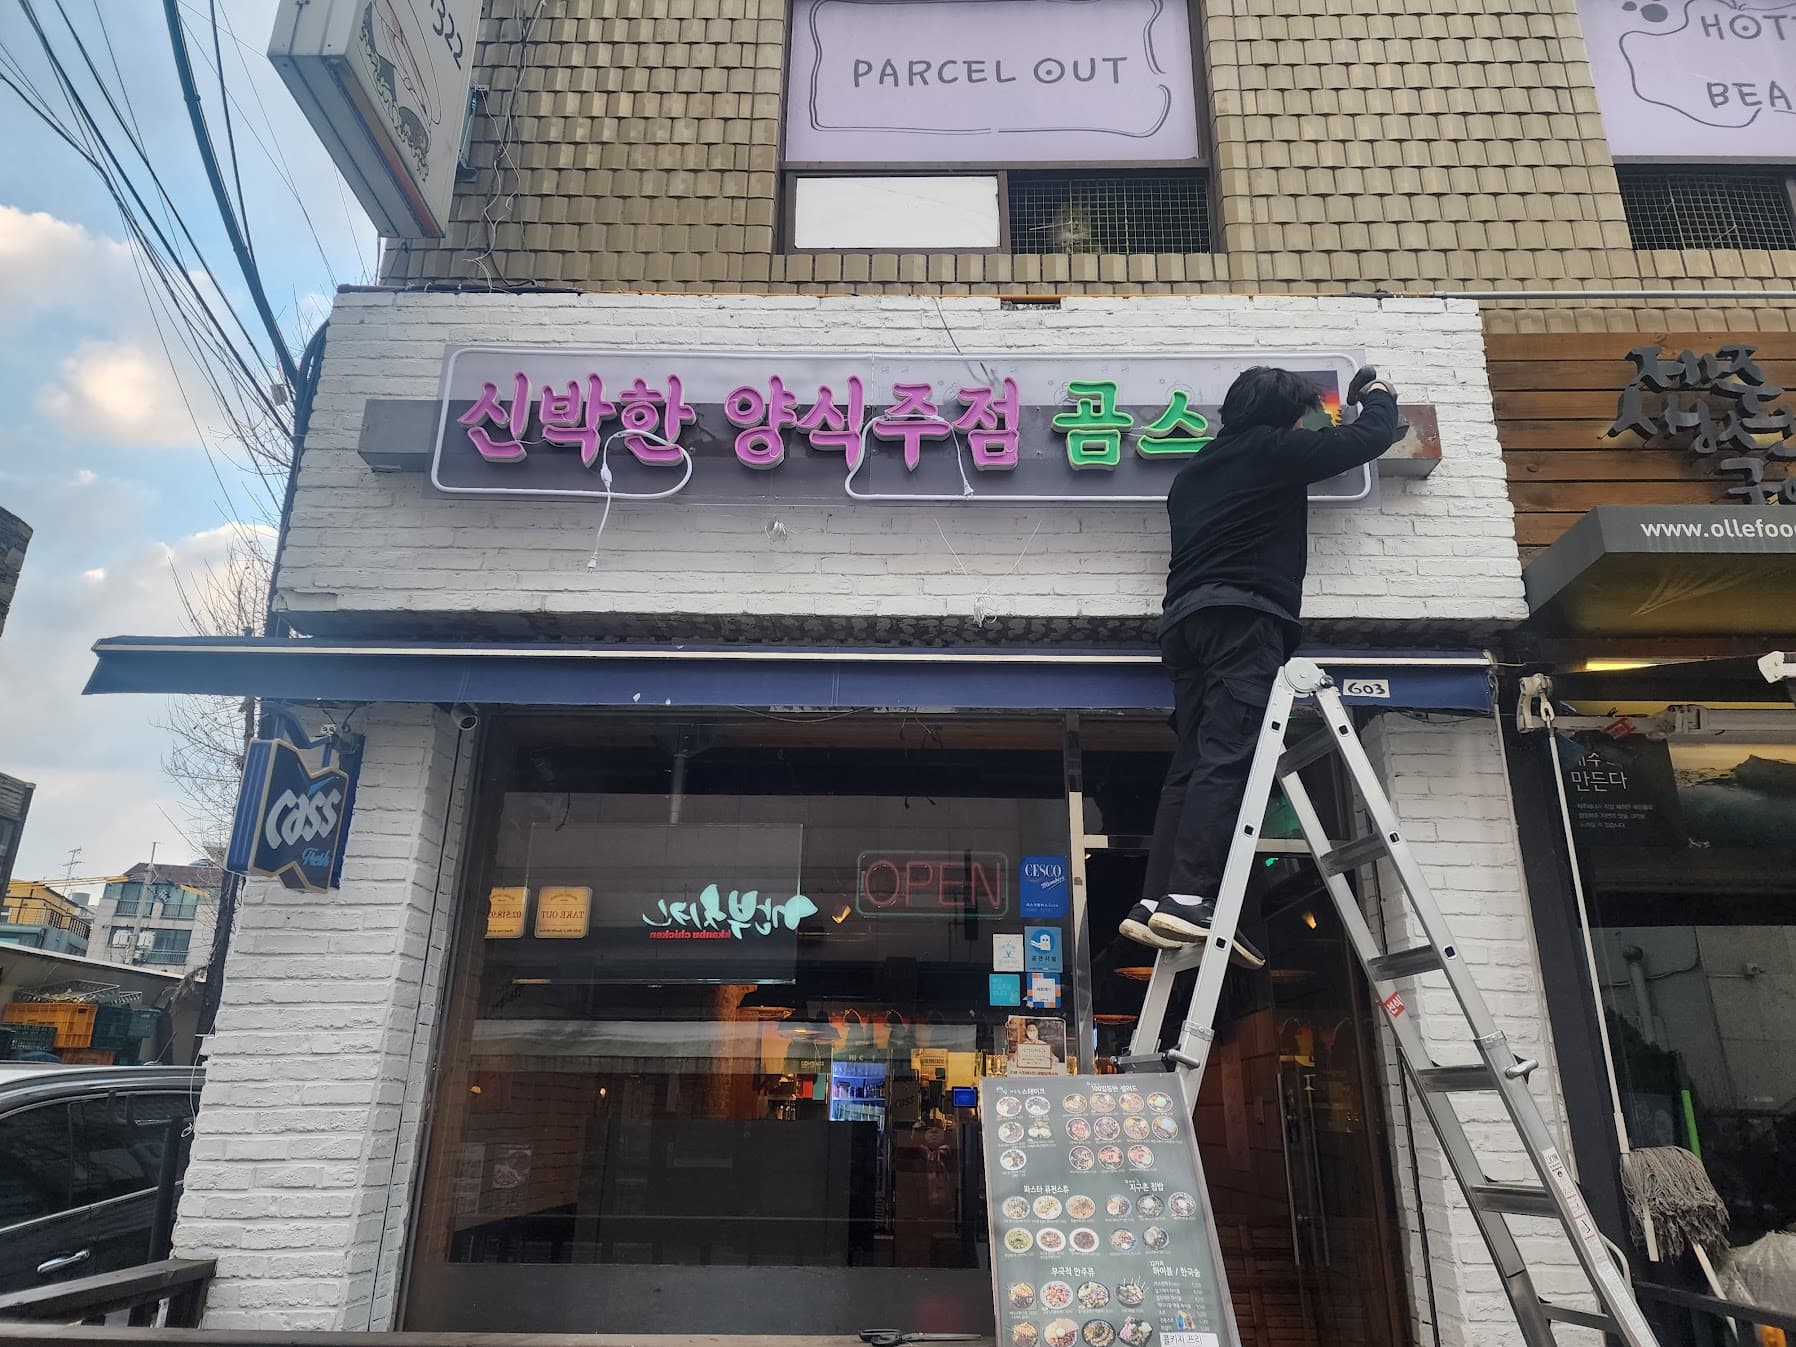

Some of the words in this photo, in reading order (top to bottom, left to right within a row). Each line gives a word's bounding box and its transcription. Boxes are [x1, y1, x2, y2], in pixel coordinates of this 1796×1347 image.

[430, 0, 464, 70] 322
[1701, 12, 1796, 41] HOT
[853, 58, 1017, 88] PARCEL
[1032, 56, 1129, 85] OUT
[1706, 80, 1794, 111] BEA
[456, 370, 698, 469] 신박한
[723, 374, 1021, 474] 양식주점
[1640, 518, 1796, 539] www.ollefoo
[1347, 682, 1385, 695] 603
[1570, 771, 1628, 792] 만든다
[1024, 863, 1063, 878] CESCO
[864, 859, 1003, 908] OPEN
[1023, 1185, 1044, 1194] 파스타
[1051, 1266, 1072, 1277] 무국적
